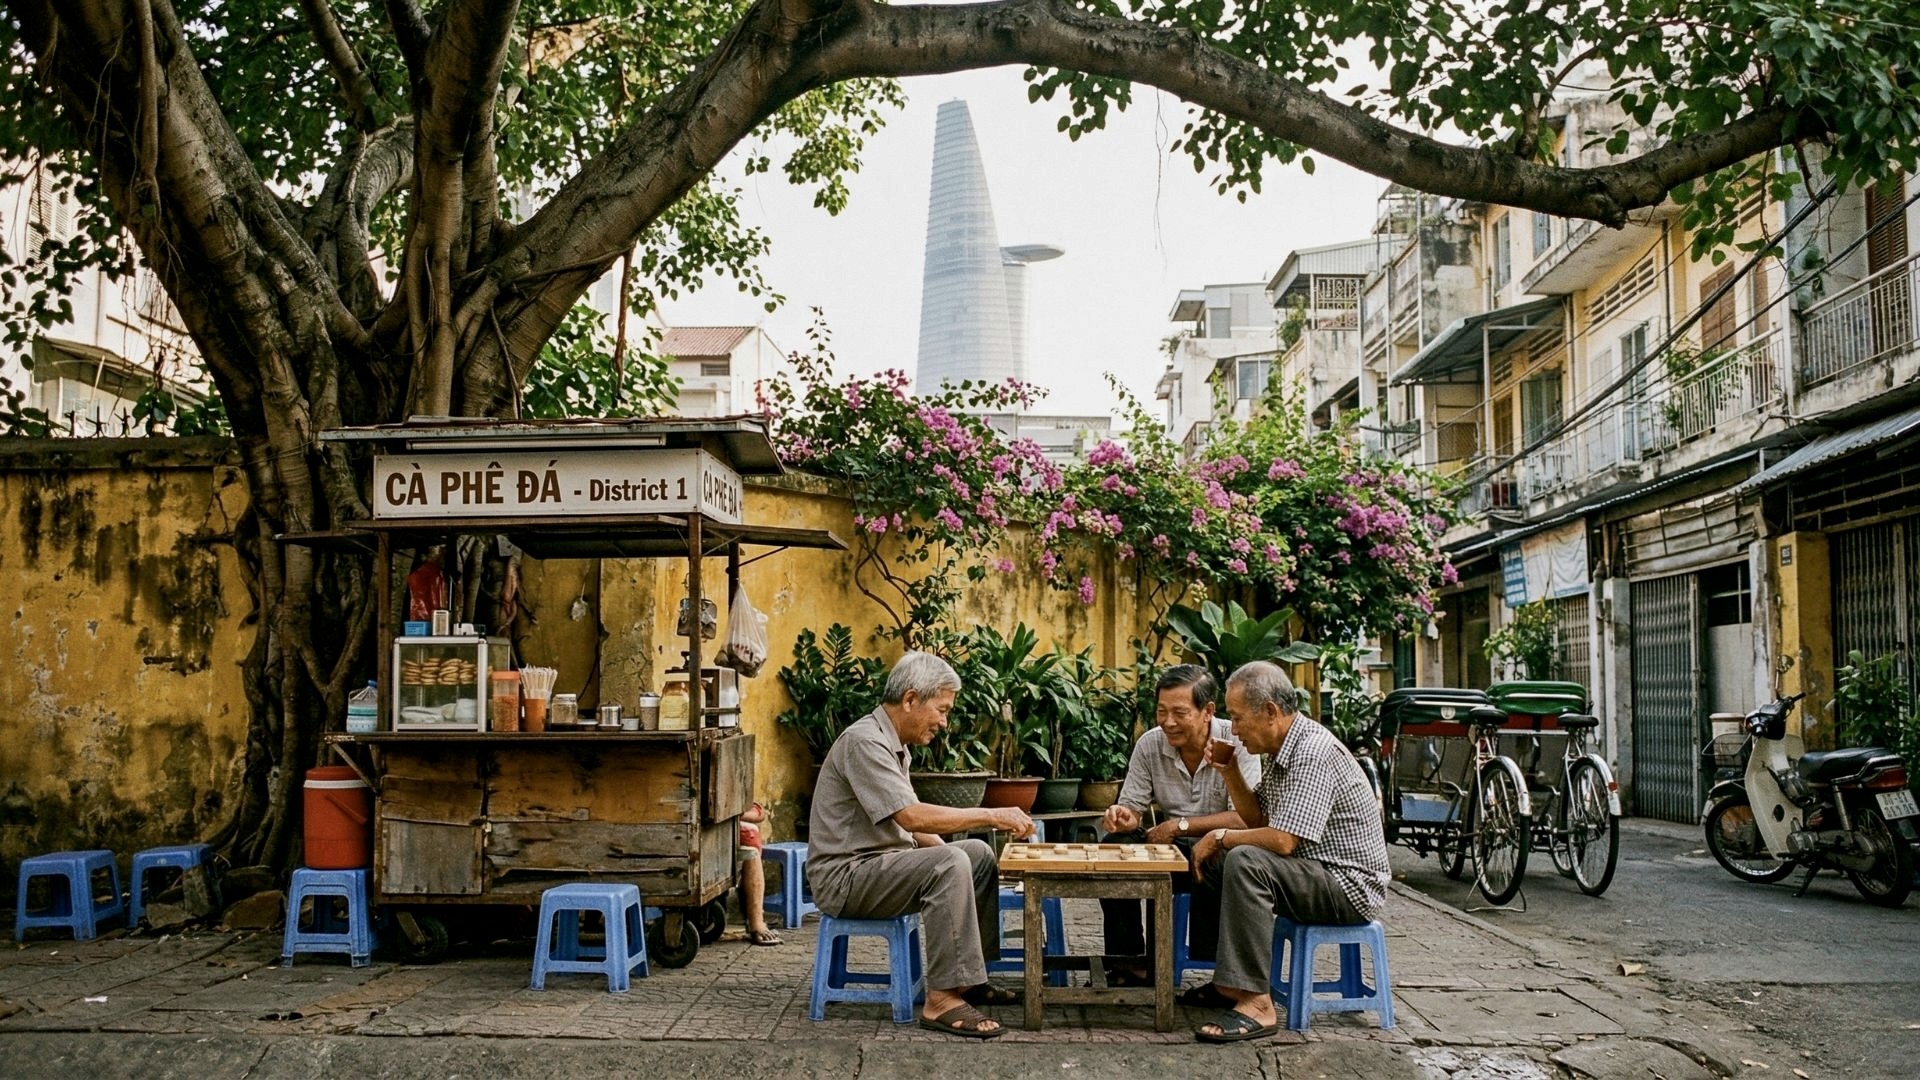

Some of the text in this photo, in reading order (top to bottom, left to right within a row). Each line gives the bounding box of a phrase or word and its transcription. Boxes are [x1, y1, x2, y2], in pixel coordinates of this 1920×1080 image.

[385, 462, 428, 506] CÀ
[440, 461, 504, 505] PHÊ
[516, 460, 562, 503] ĐÁ
[590, 477, 669, 502] District
[676, 477, 688, 500] 1
[714, 474, 727, 512] PHÊ
